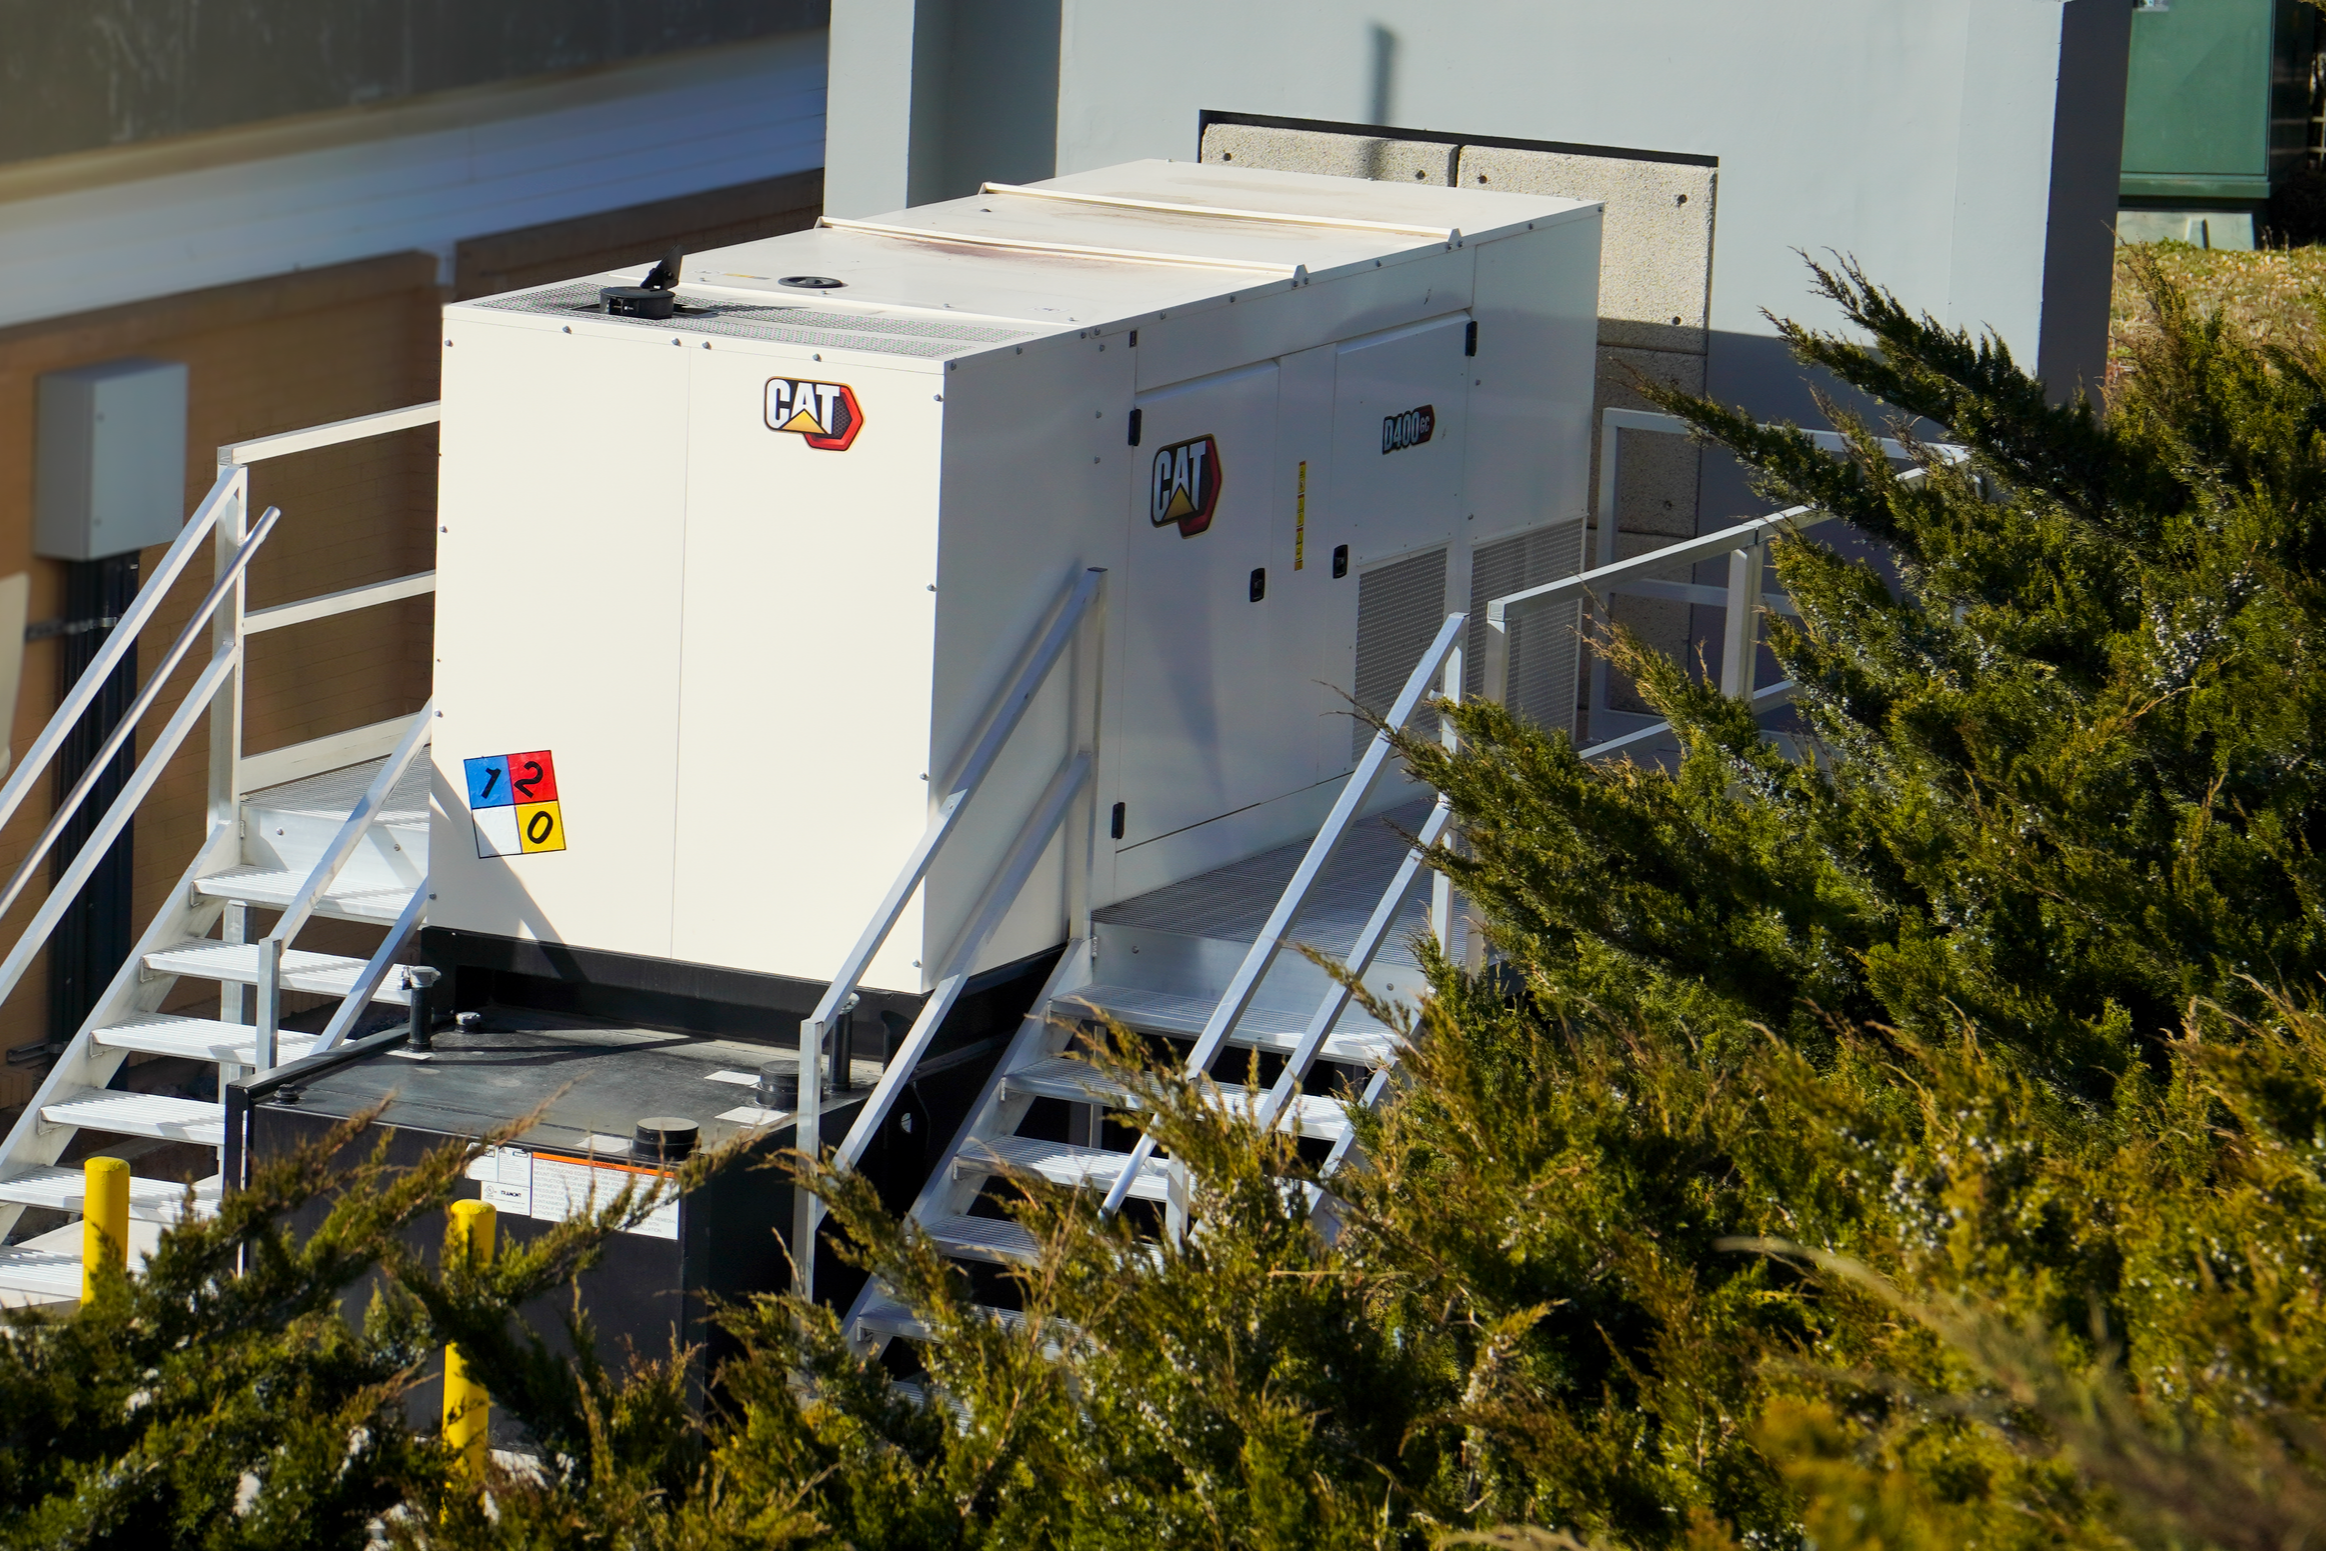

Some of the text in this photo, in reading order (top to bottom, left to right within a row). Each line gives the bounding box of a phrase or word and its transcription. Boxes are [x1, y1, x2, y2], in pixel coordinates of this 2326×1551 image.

[766, 378, 840, 434] CAT
[1384, 411, 1421, 451] D400
[1152, 440, 1207, 522] CAT
[480, 767, 502, 799] 1
[513, 760, 544, 799] 2
[526, 810, 554, 844] 0
